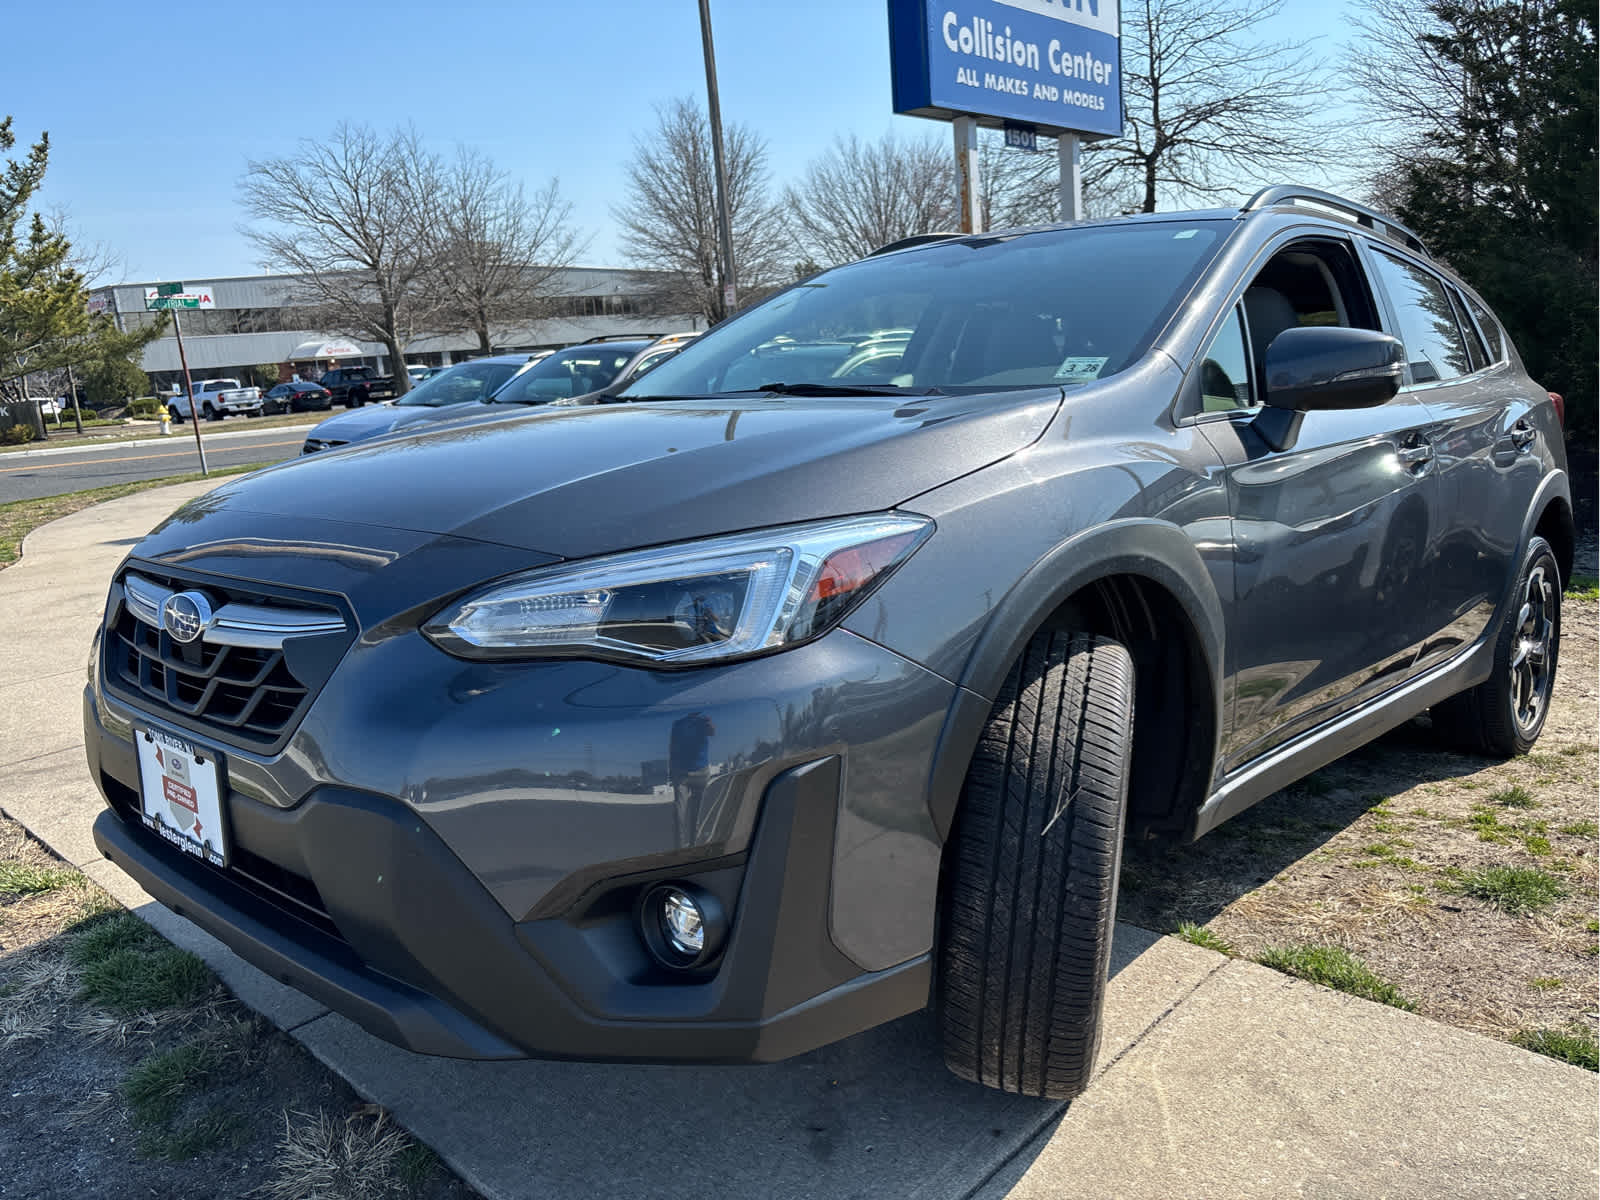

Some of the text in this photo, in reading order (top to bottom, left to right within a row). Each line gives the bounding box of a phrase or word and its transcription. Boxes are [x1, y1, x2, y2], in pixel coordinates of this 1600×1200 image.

[942, 11, 1112, 85] Collision Center
[956, 67, 1105, 111] ALL MAKES AND MODELS
[1007, 129, 1035, 147] 1501
